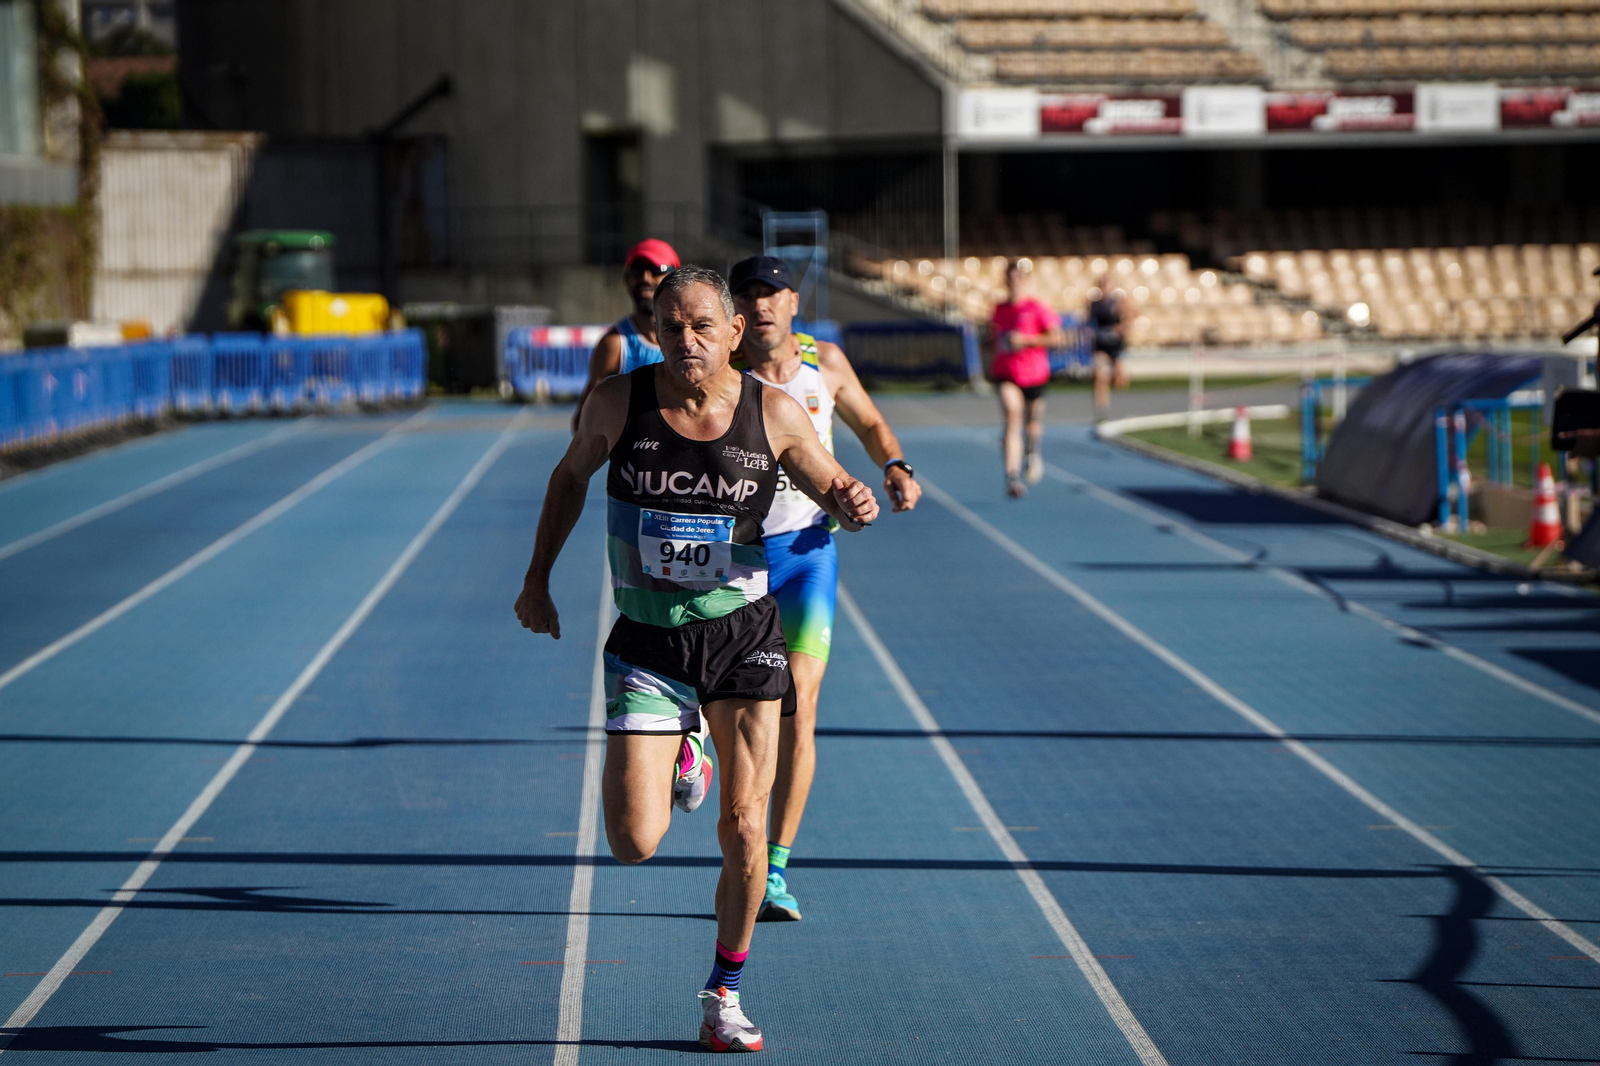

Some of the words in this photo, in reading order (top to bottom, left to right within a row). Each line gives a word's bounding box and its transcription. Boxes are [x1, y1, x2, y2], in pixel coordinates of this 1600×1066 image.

[632, 470, 759, 503] JUCAMP
[660, 524, 685, 532] Ciudad
[695, 526, 715, 534] Jerez
[670, 516, 696, 524] Carrera
[660, 541, 710, 567] 940
